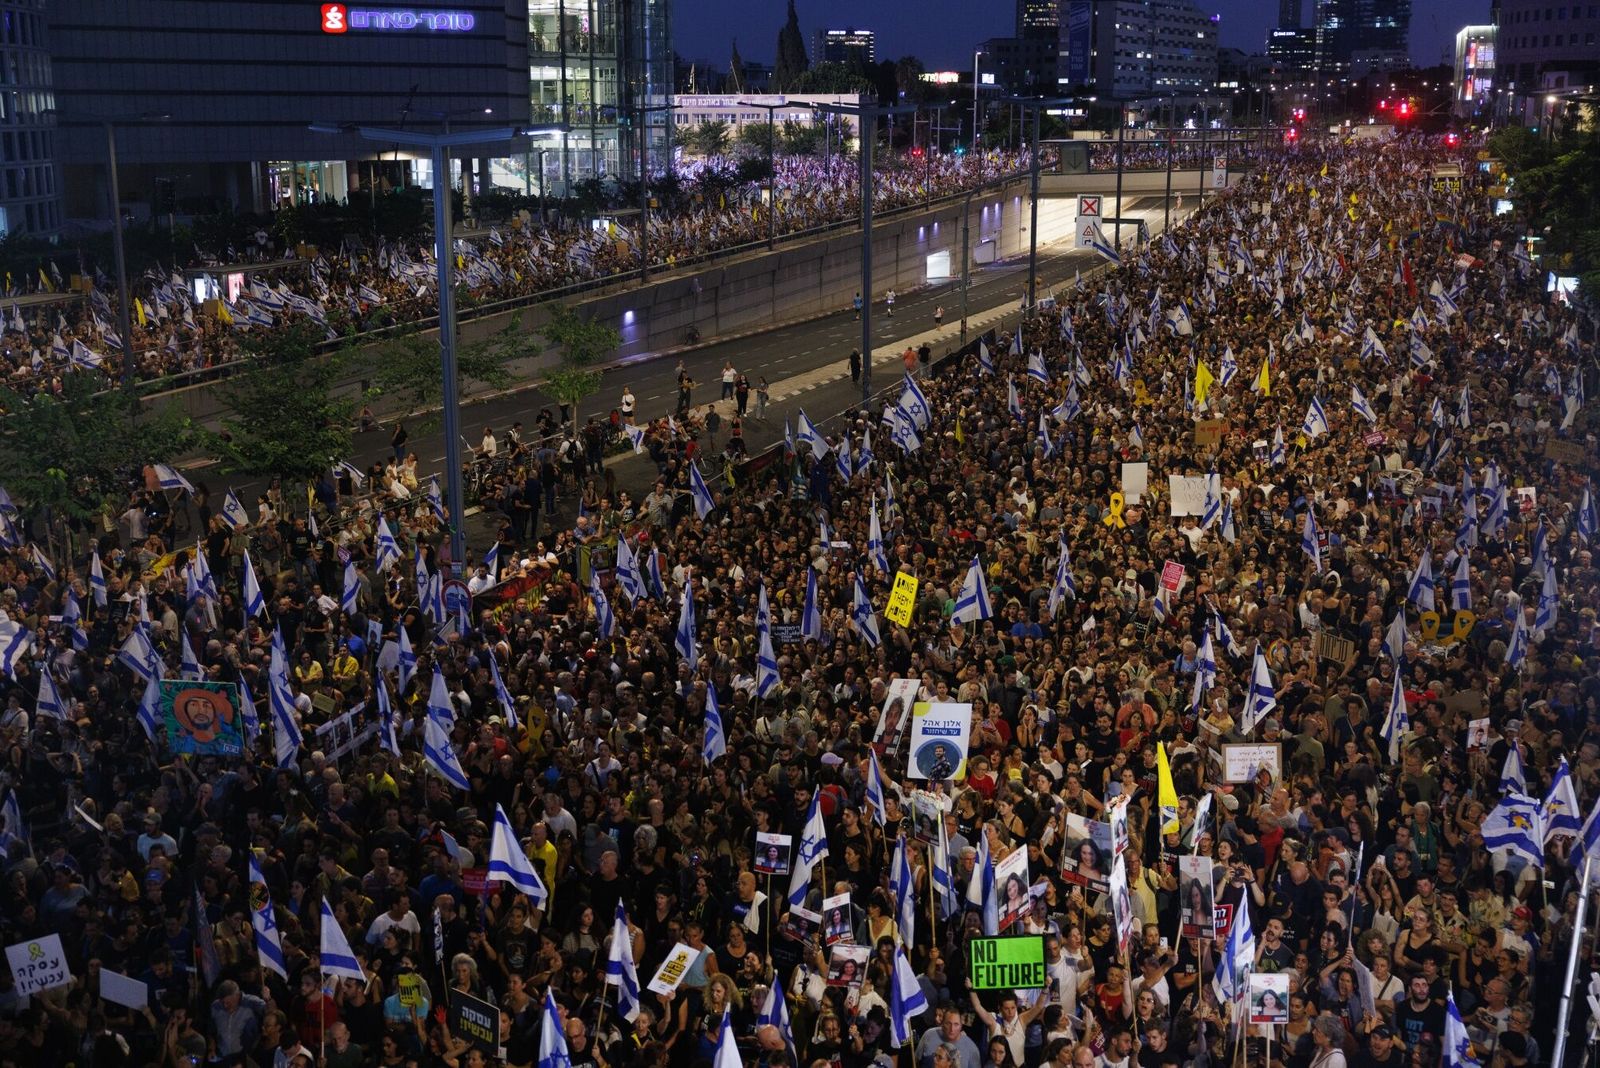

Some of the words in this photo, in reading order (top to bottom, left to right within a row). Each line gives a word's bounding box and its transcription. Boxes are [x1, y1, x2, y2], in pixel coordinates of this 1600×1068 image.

[350, 11, 475, 31] סופר-פארם
[922, 718, 940, 727] אהל
[943, 719, 962, 728] אלון
[973, 940, 997, 963] NO
[16, 957, 60, 978] עסקה
[974, 962, 1043, 987] FUTURE
[20, 971, 64, 993] עכשיו!
[461, 1006, 492, 1029] עסקה
[459, 1017, 494, 1044] עכשיו!
